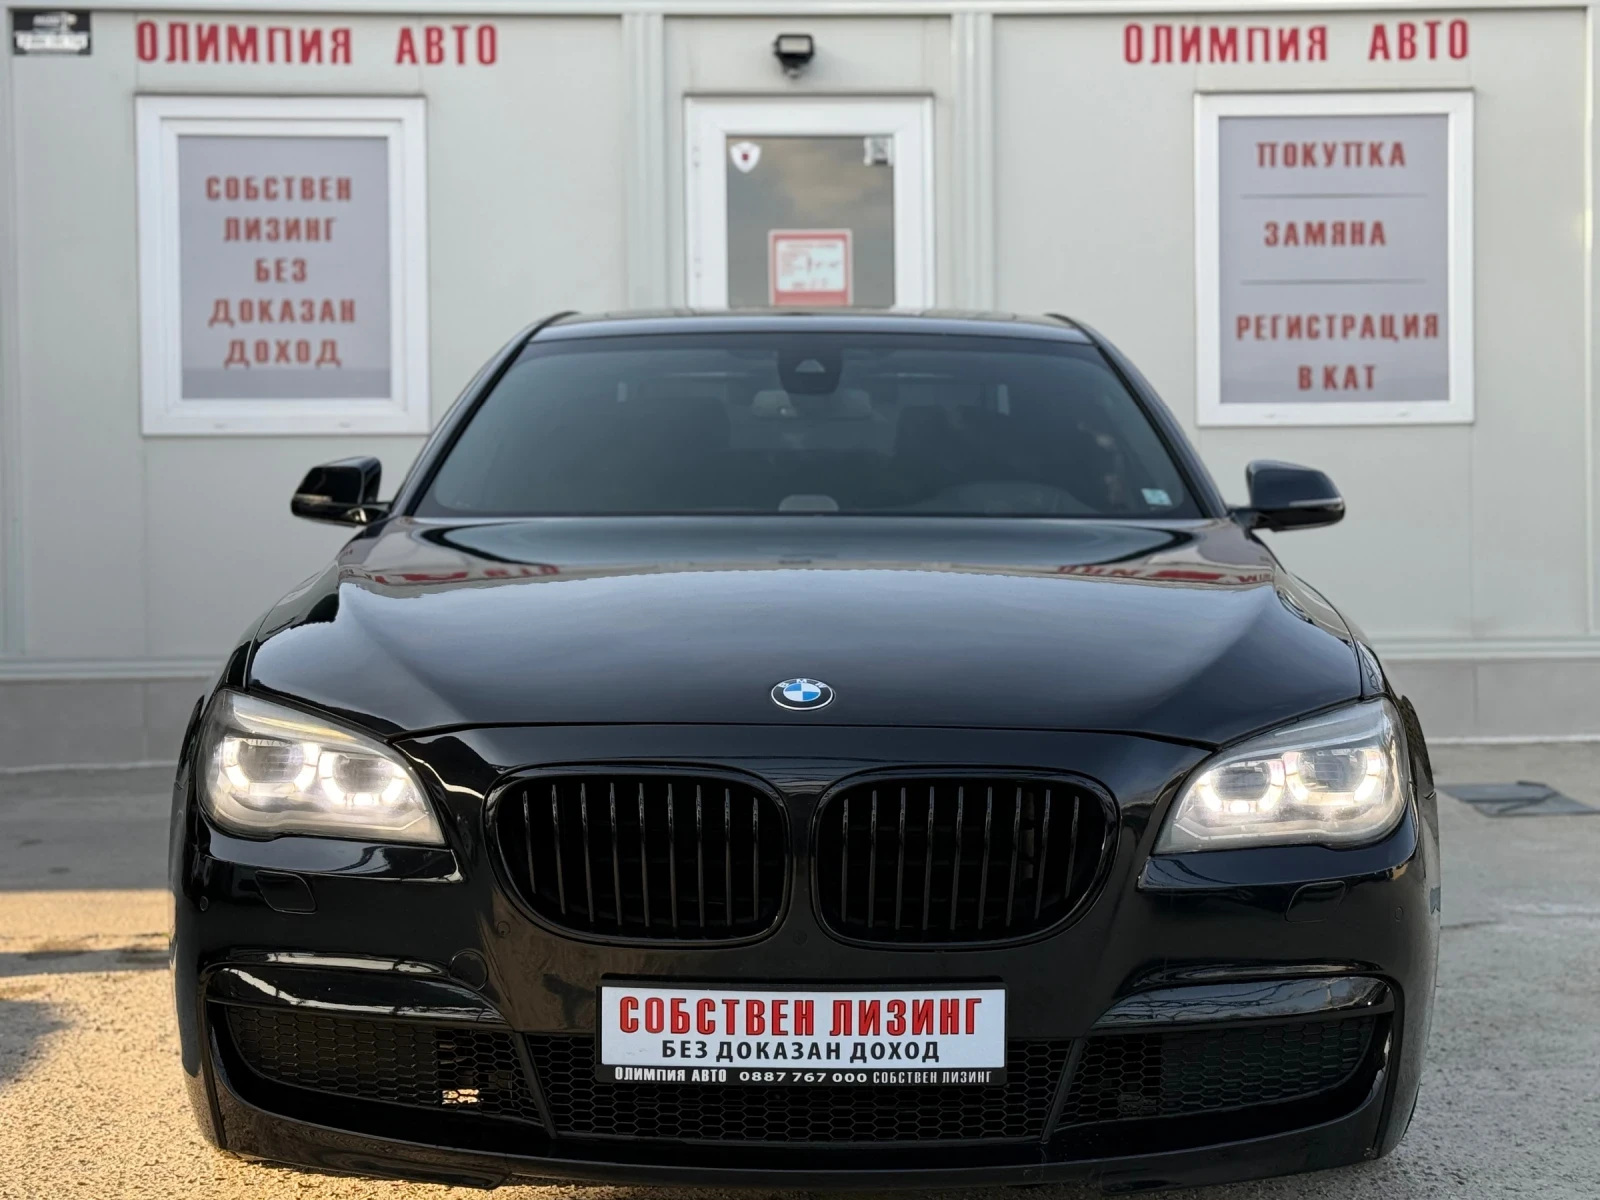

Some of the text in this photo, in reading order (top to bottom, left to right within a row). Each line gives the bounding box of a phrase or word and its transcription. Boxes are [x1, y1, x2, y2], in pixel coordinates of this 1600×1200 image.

[137, 22, 351, 63] ОЛИМПИЯ
[395, 25, 498, 66] АВТО
[1125, 20, 1470, 63] ОЛИМПИЯ АВТО
[1256, 142, 1406, 168] ПОКУПКА
[206, 177, 351, 200] СОБСТВЕН
[225, 217, 336, 241] ЛИЗИНГ
[1264, 221, 1386, 247] ЗАМЯНА
[255, 259, 307, 282] БЕЗ
[209, 299, 355, 327] ДОКАЗАН
[1236, 314, 1438, 343] РЕГИСТРАЦИЯ
[224, 339, 341, 368] ДОХОД
[1298, 365, 1376, 390] В КАТ
[778, 679, 828, 688] BMW
[620, 997, 982, 1036] СОБСТВЕН ЛИЗИНГ
[663, 1040, 939, 1063] БЕЗ ДОКАЗАН ДОХОД
[615, 1067, 991, 1084] ОЛИМПИЯ АВТО 0887 767 000 СОБСТВЕН ЛИЗИНГ
